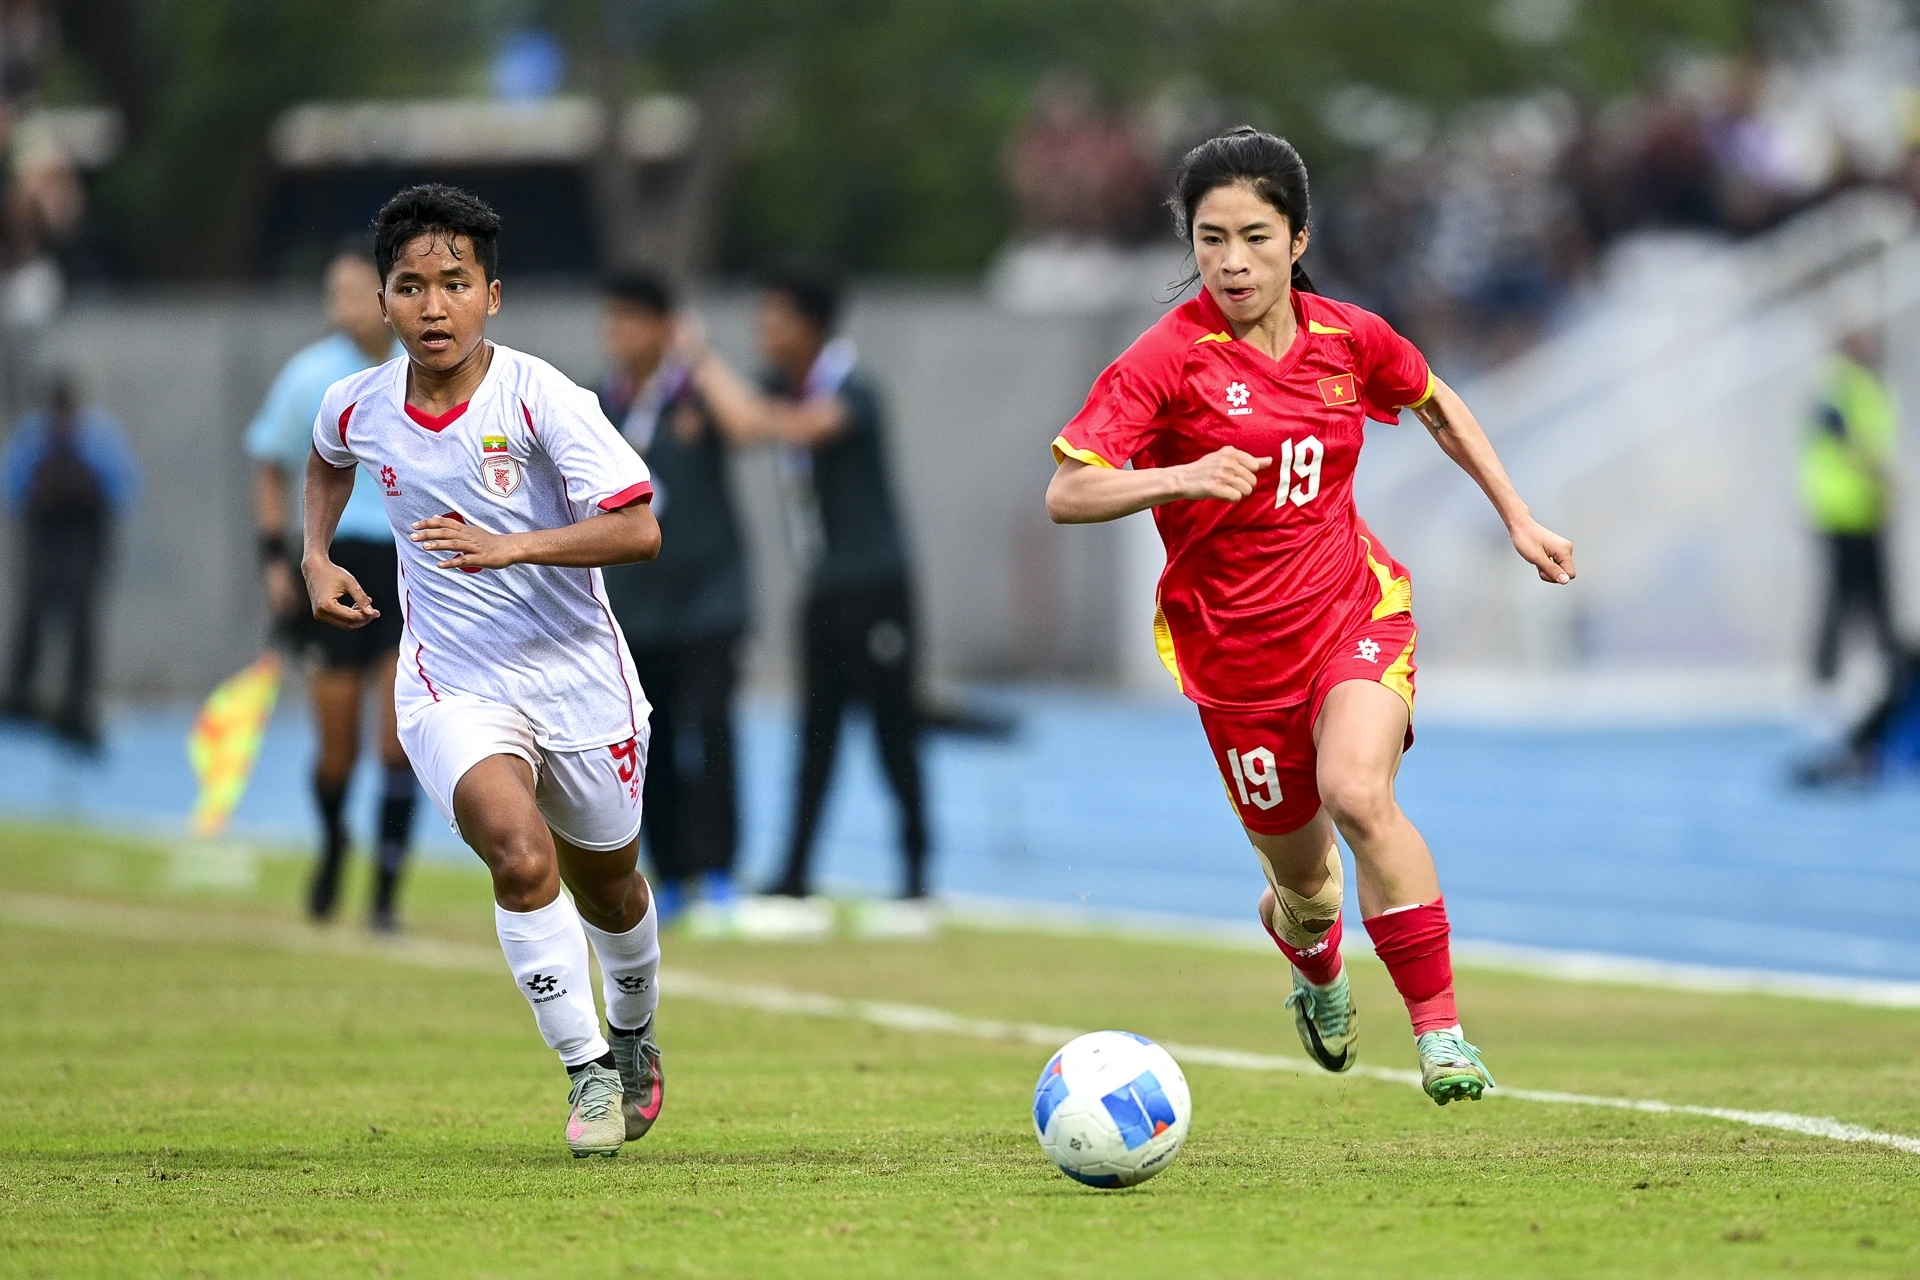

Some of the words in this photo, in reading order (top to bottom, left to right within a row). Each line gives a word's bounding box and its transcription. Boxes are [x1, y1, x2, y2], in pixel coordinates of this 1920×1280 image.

[1274, 434, 1324, 510] 19
[608, 737, 638, 783] 9
[1226, 746, 1284, 811] 19
